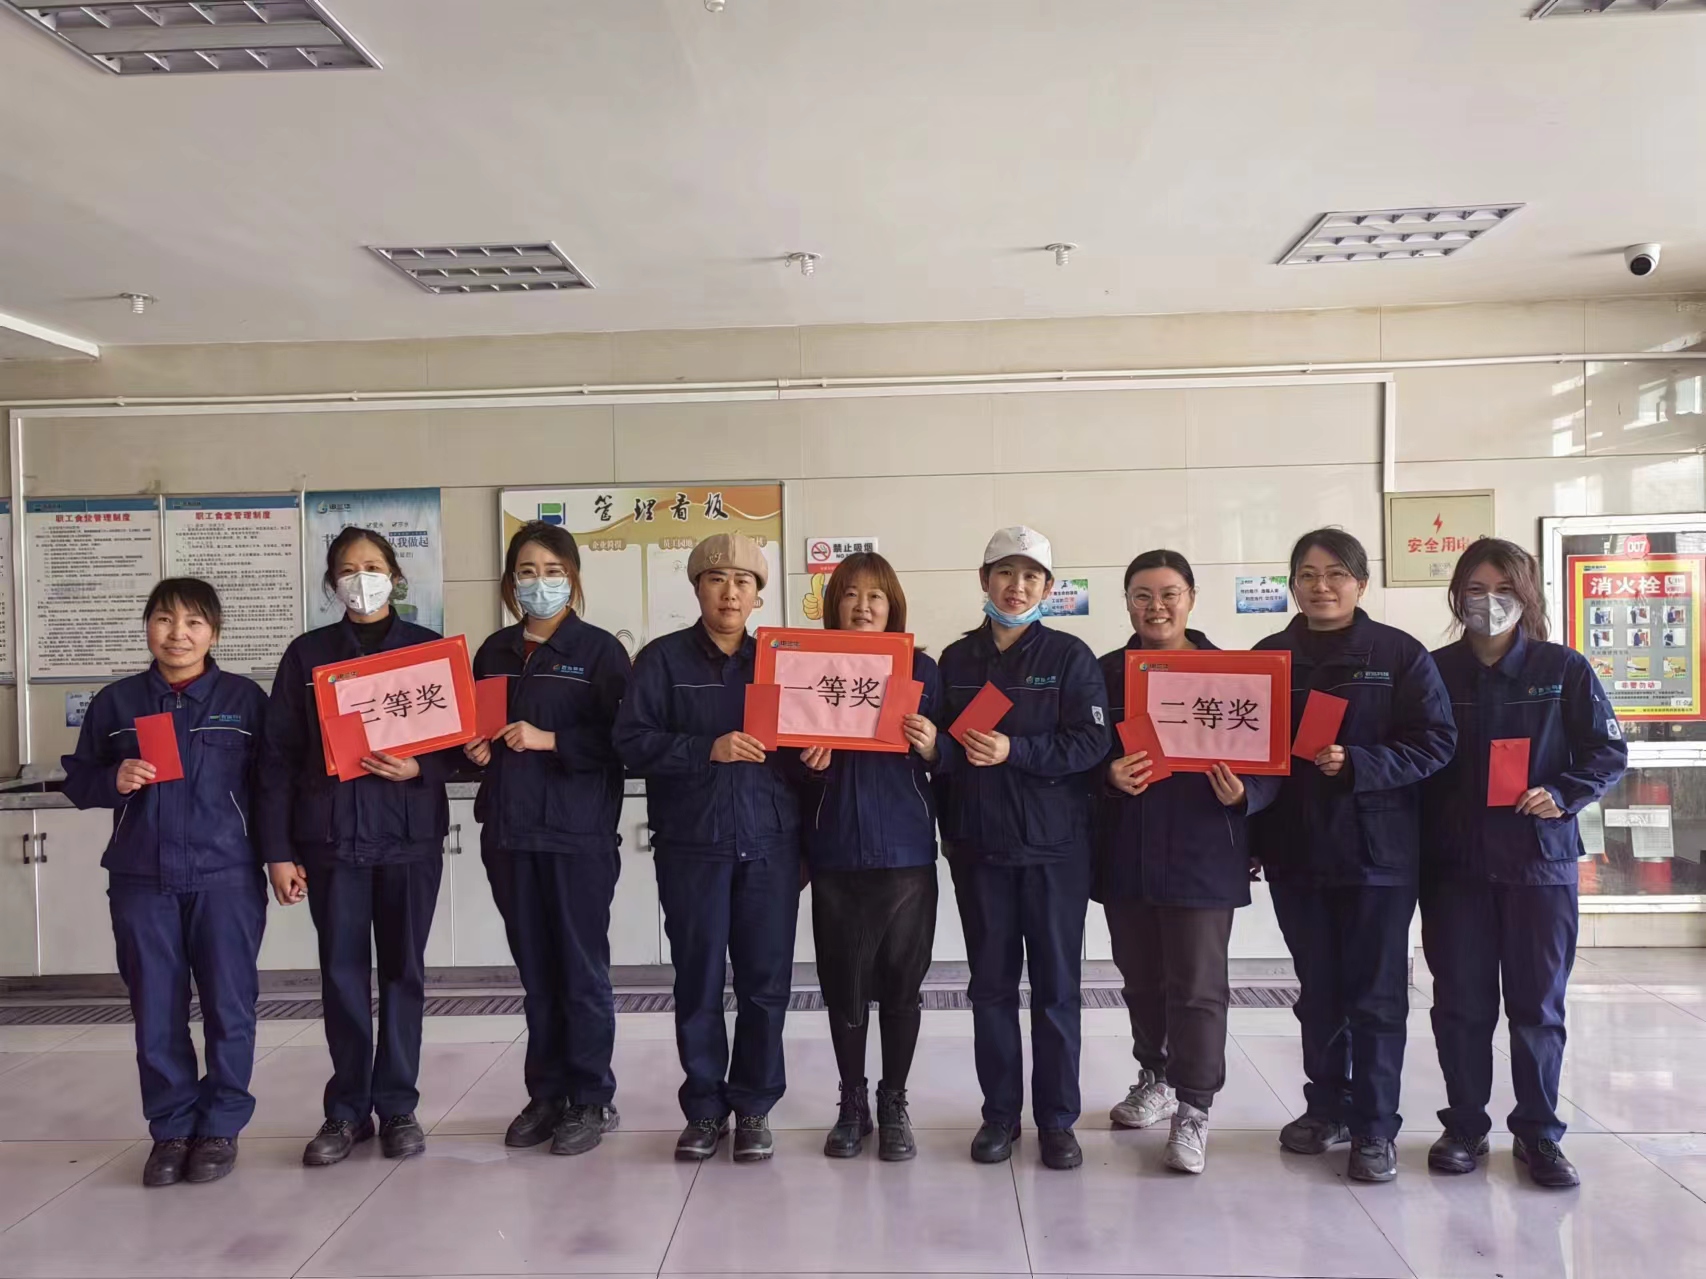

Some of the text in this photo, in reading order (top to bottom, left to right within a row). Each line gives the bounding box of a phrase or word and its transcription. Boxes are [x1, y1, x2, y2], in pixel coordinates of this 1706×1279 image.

[195, 511, 271, 521] 职工食堂管理制度
[593, 491, 729, 523] 管理看板
[55, 513, 131, 523] 职工食堂管理制度
[832, 542, 874, 553] 禁止吸烟
[1626, 541, 1647, 554] 007
[1589, 576, 1662, 596] 消火栓
[783, 675, 881, 708] 一等奖
[350, 683, 448, 724] 三等奖
[1157, 697, 1260, 731] 二等奖
